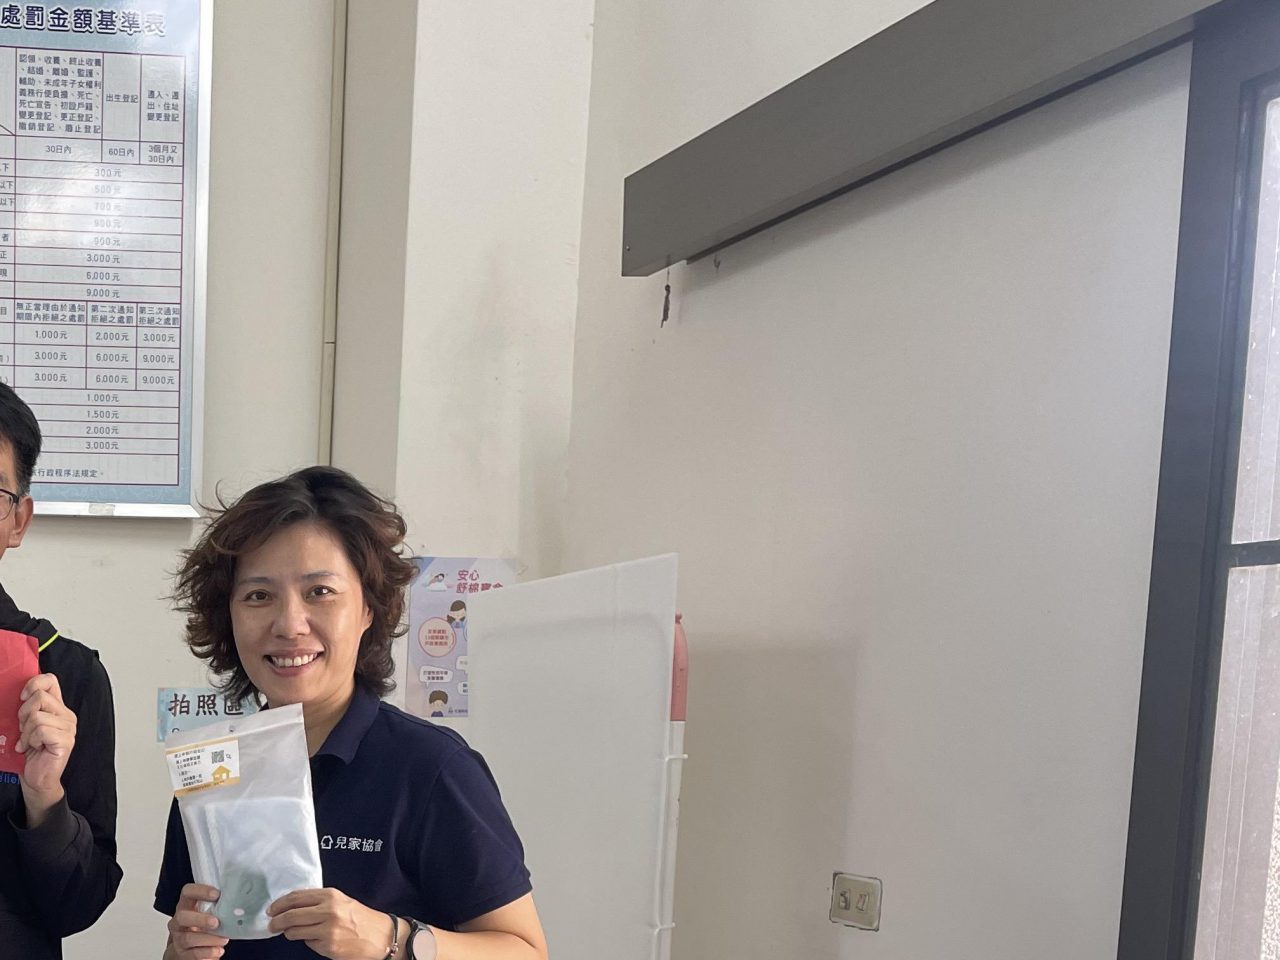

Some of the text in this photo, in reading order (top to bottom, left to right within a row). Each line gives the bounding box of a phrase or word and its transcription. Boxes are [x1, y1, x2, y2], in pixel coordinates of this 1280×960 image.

[168, 693, 244, 717] 拍照區
[334, 836, 383, 852] 兒家協會
